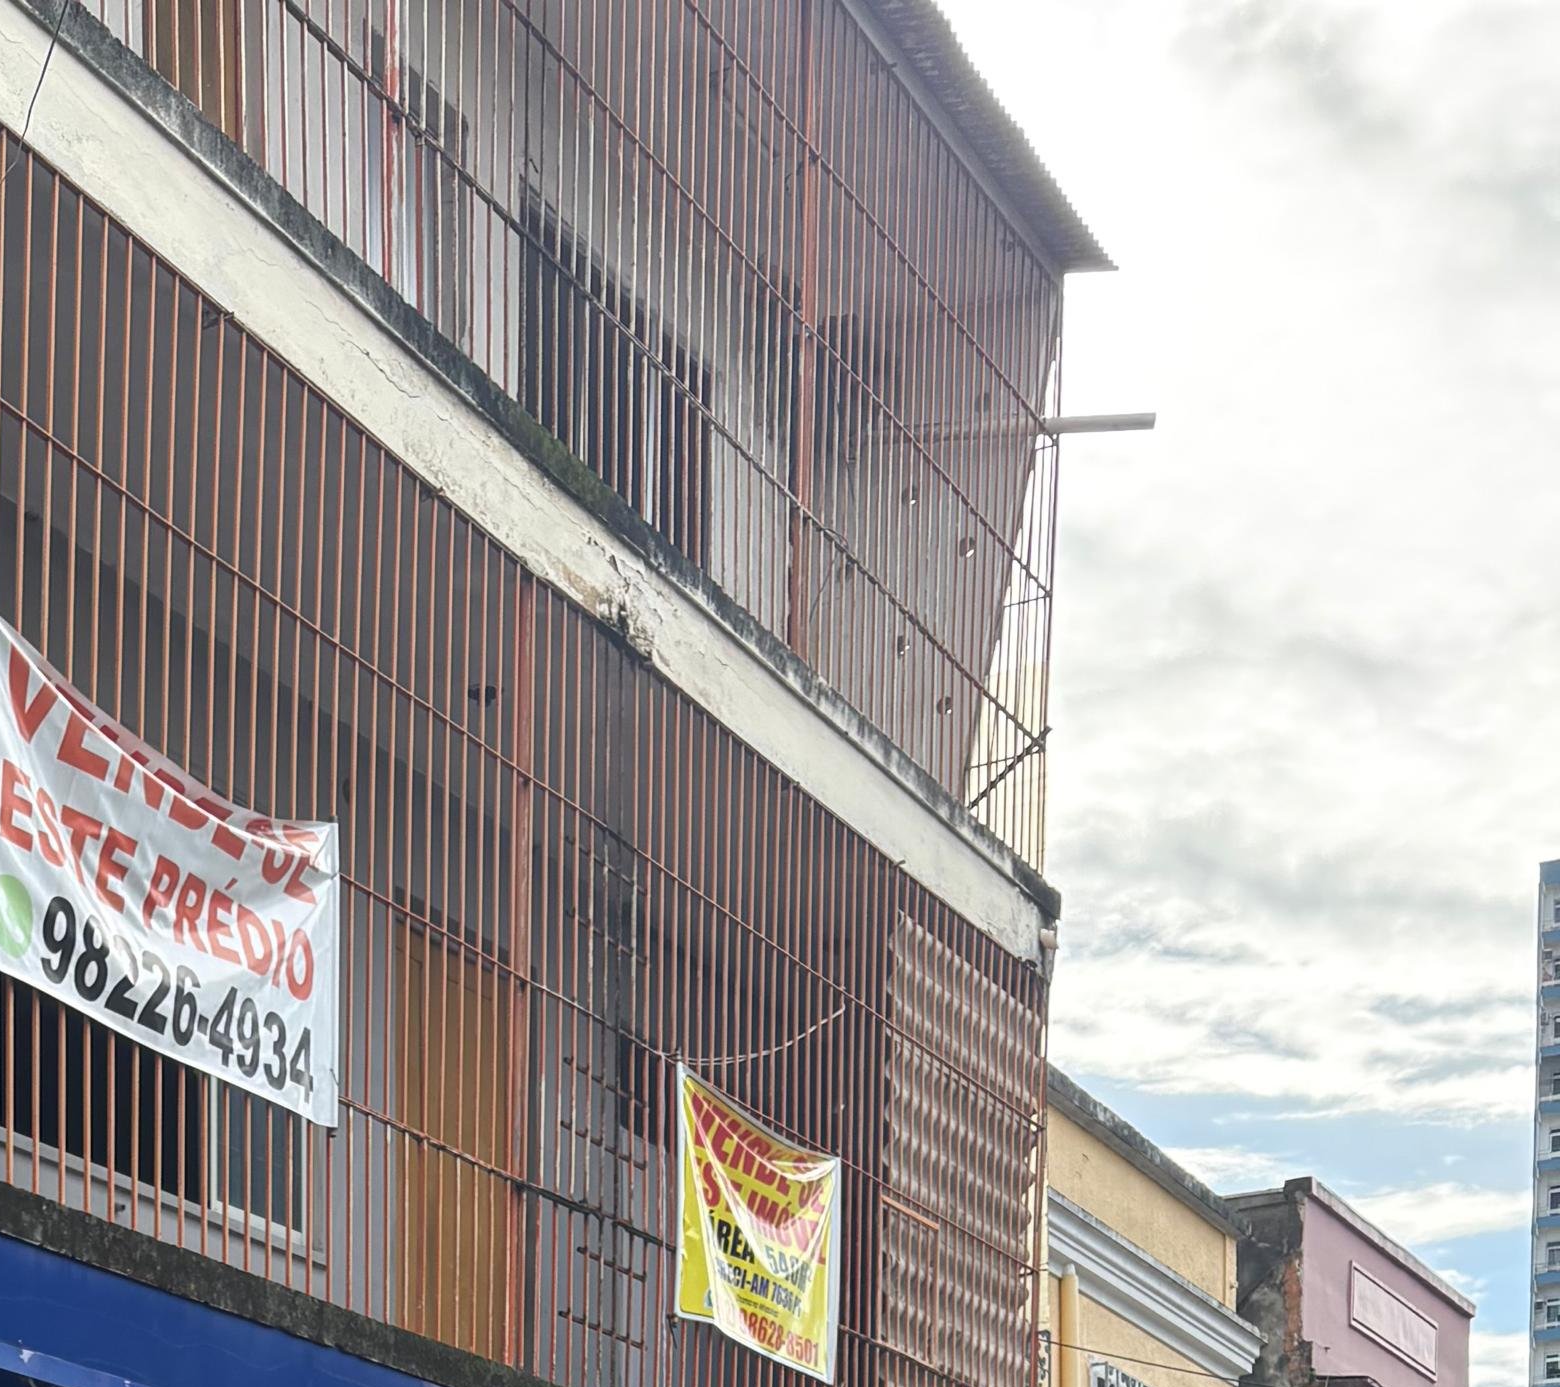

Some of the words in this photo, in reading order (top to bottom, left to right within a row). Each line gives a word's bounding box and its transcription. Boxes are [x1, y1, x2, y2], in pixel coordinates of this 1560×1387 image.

[0, 759, 138, 915] ESTE
[142, 854, 315, 1002] PRÉDIO
[40, 895, 315, 1104] 98226-4934
